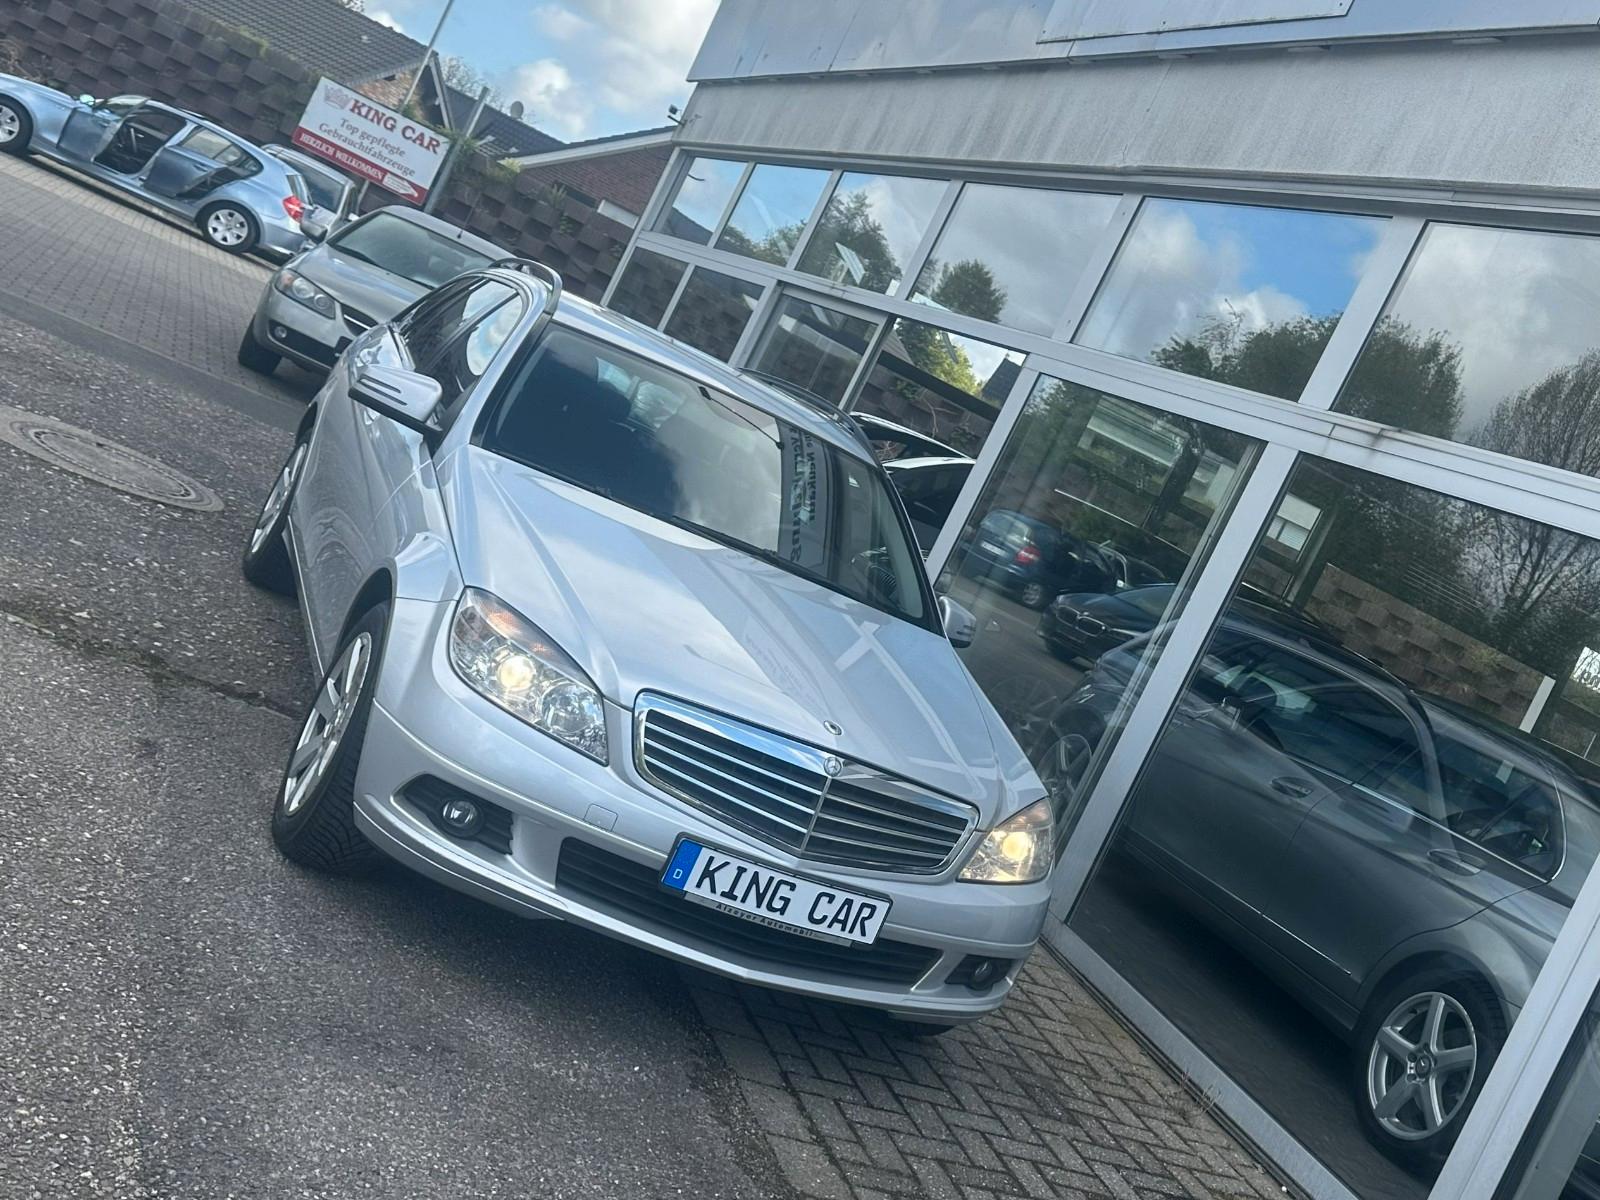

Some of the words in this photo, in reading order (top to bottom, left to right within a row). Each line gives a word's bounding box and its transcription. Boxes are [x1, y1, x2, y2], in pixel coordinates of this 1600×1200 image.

[319, 122, 416, 178] Gebrauchtfahrzeuge
[341, 118, 360, 136] Top
[358, 130, 406, 158] gepflegte
[349, 99, 397, 133] KING
[401, 125, 441, 155] CAR
[672, 869, 683, 880] D
[695, 855, 797, 916] KING
[807, 891, 878, 937] CAR
